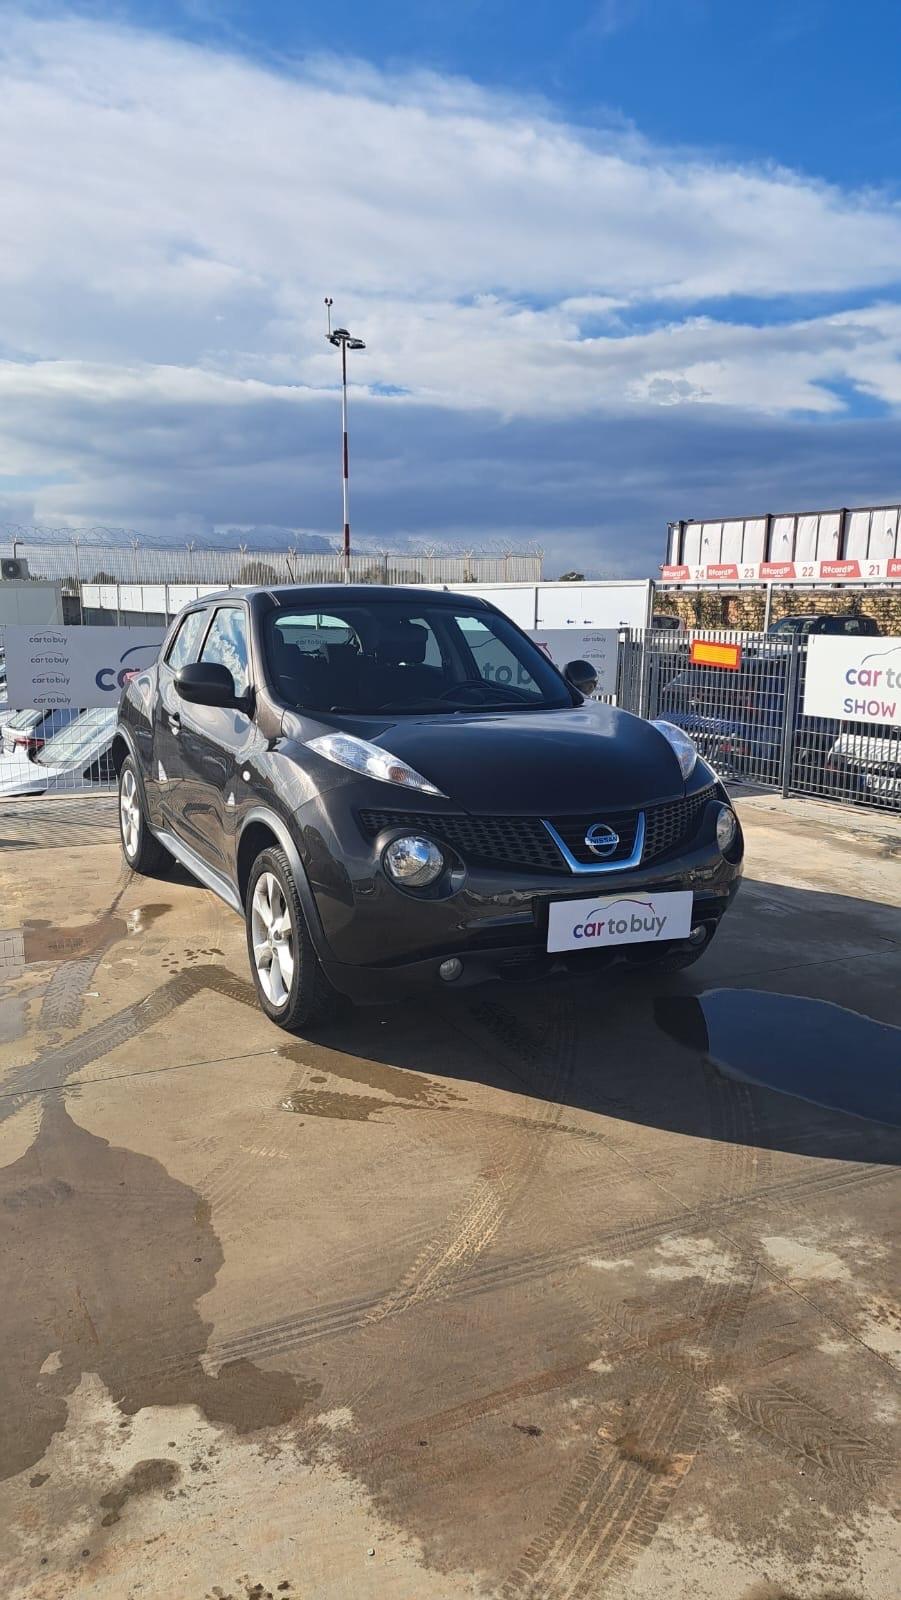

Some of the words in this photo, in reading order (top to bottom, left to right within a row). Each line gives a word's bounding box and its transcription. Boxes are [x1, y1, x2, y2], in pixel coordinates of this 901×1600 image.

[695, 569, 704, 579] 24
[744, 568, 754, 578] 23
[802, 566, 814, 577] 22
[869, 564, 880, 576] 21
[845, 668, 882, 687] car
[843, 698, 897, 718] SHOW
[590, 834, 618, 844] NISSAN
